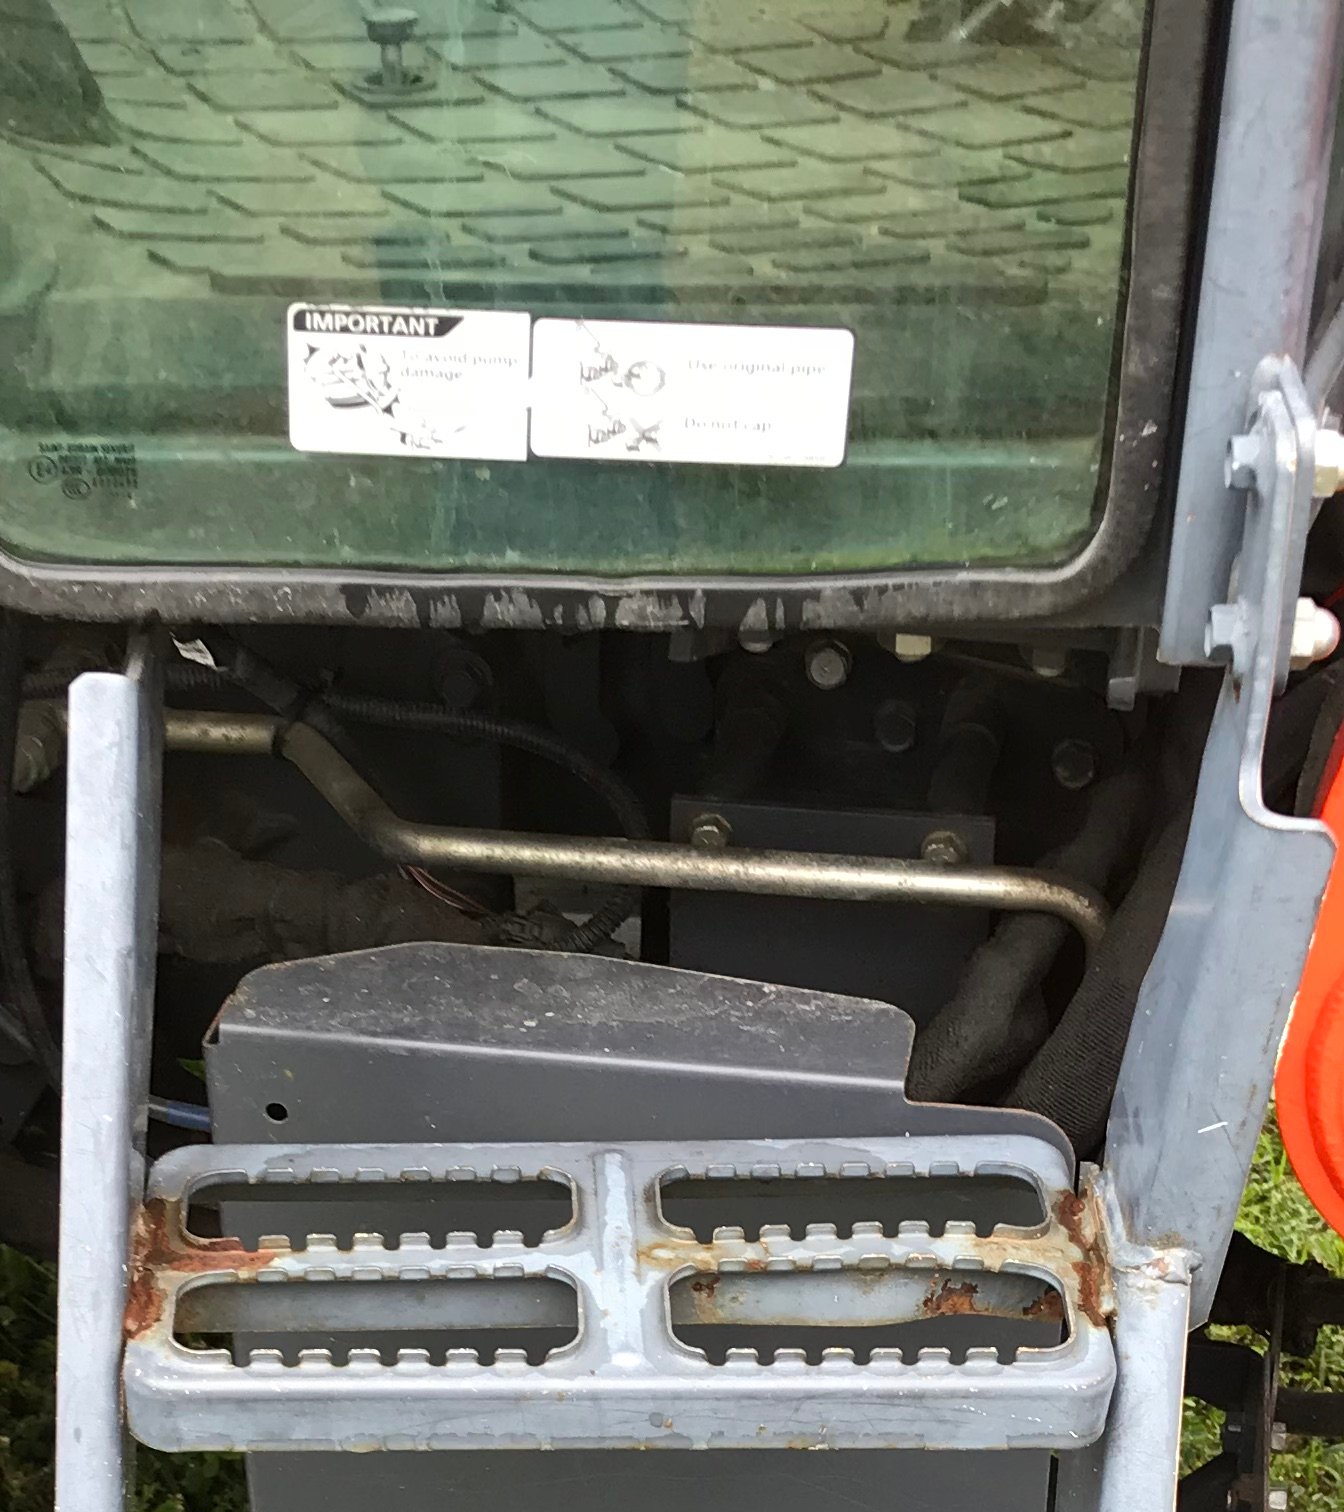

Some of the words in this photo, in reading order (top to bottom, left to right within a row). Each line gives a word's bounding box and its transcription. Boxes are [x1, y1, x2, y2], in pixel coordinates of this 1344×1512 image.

[304, 311, 439, 337] IMPORTANT
[400, 366, 464, 382] damage
[722, 361, 786, 375] original
